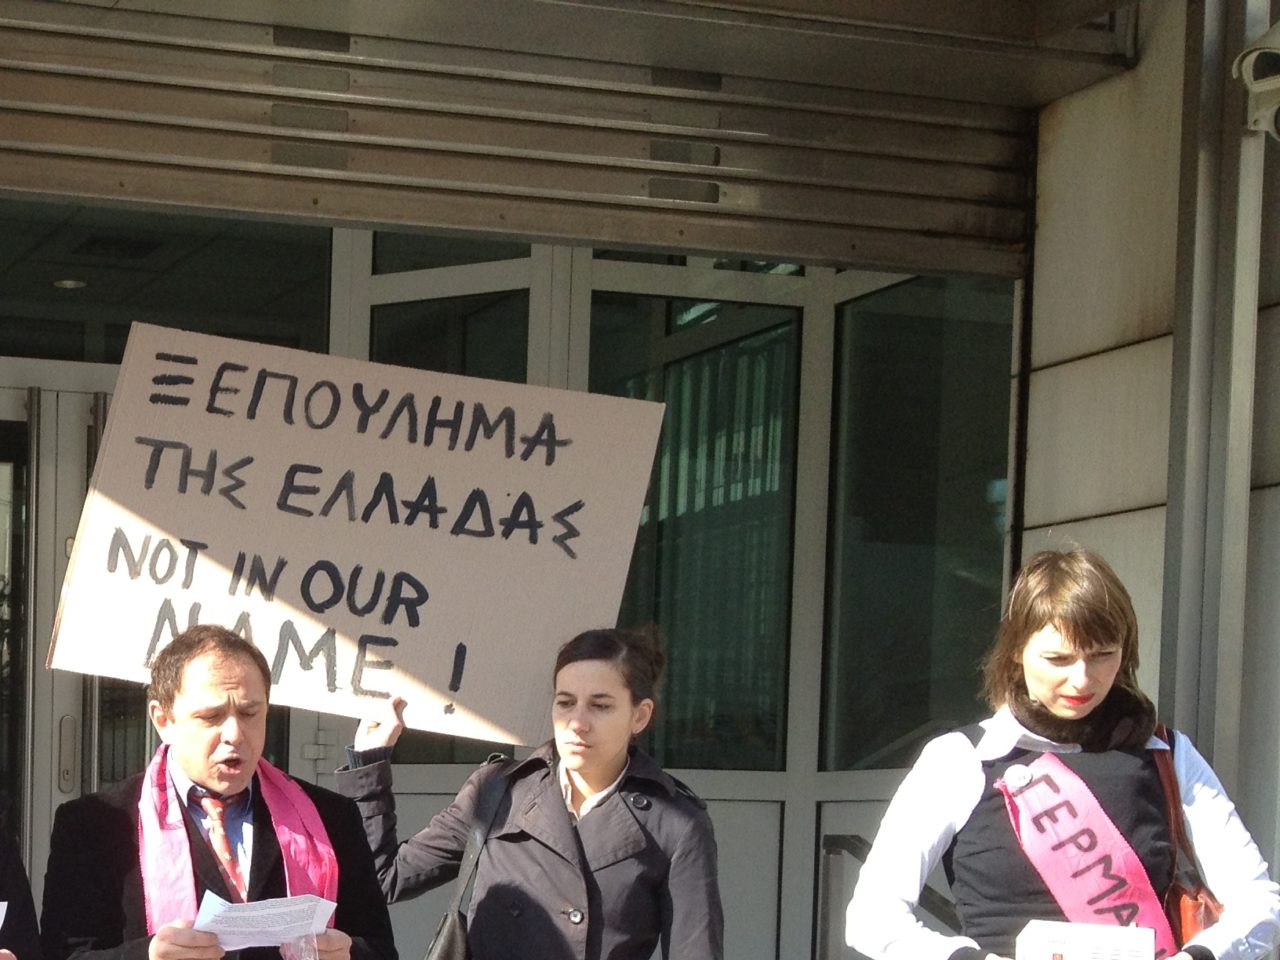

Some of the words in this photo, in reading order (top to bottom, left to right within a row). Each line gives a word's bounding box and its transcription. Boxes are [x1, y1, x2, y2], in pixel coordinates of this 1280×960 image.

[148, 351, 573, 466] ΞΕΠΟΥΛΗΜΑ
[135, 436, 254, 510] ΤΗΣ
[276, 463, 585, 559] ΕΛΛΑΔΑΣ
[107, 527, 207, 589] NOT
[229, 550, 288, 602] IN
[300, 560, 429, 628] OUR
